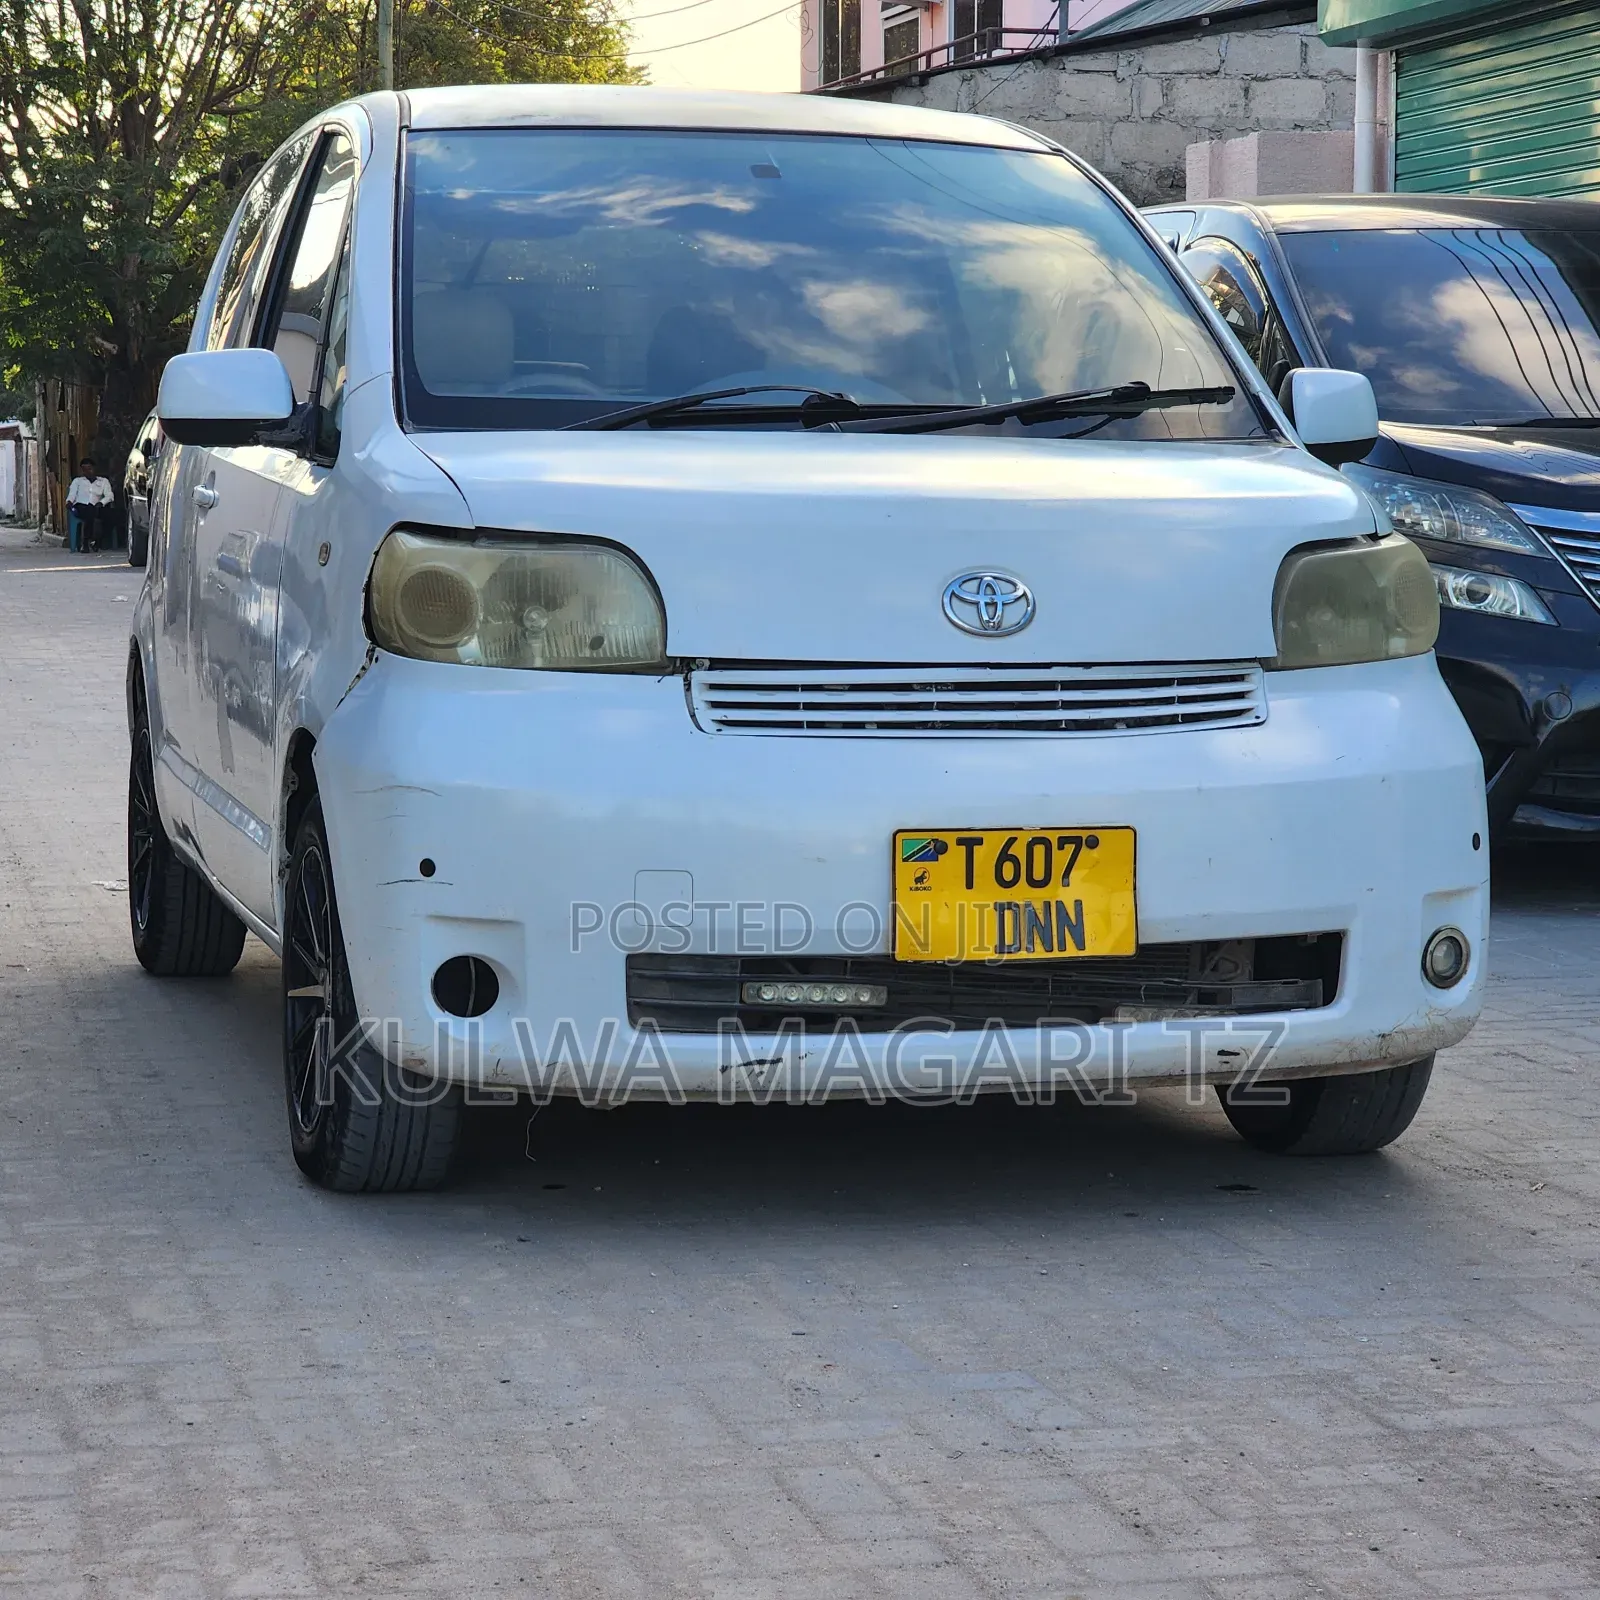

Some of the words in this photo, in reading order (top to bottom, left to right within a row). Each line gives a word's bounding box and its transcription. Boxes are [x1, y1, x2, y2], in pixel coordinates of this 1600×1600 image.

[956, 836, 984, 890] T
[994, 835, 1084, 889] 607
[993, 899, 1086, 955] DNN
